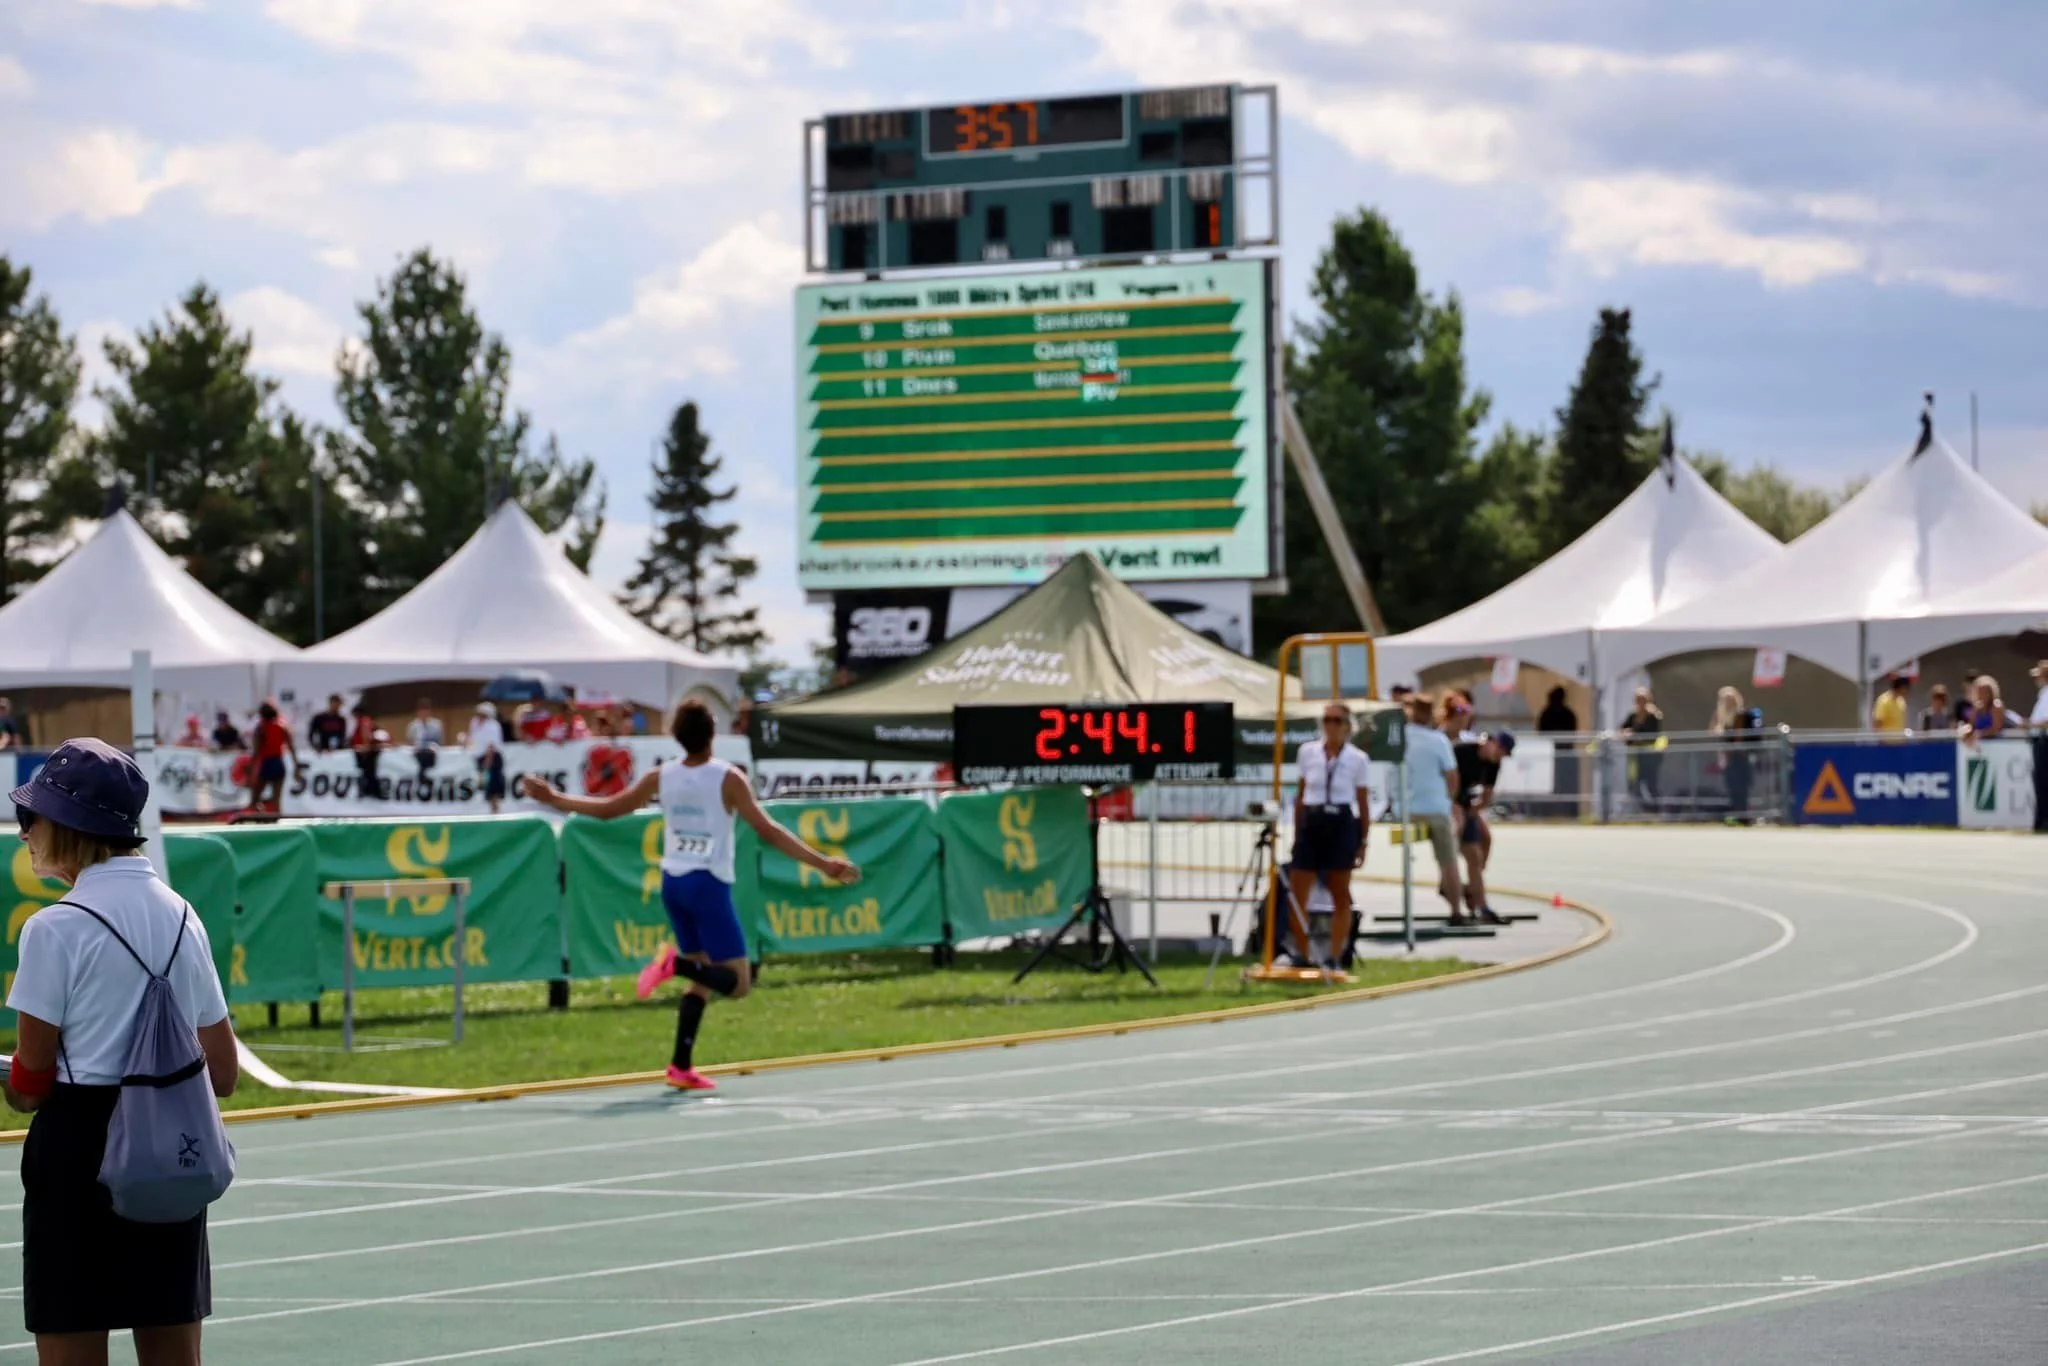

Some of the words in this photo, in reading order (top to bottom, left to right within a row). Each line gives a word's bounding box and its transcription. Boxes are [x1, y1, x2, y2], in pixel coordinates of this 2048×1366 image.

[954, 102, 1038, 151] 3:57
[1023, 763, 1132, 783] PERFORMANCE
[1155, 762, 1221, 779] ATTEMPT
[1853, 772, 1950, 799] CANAC
